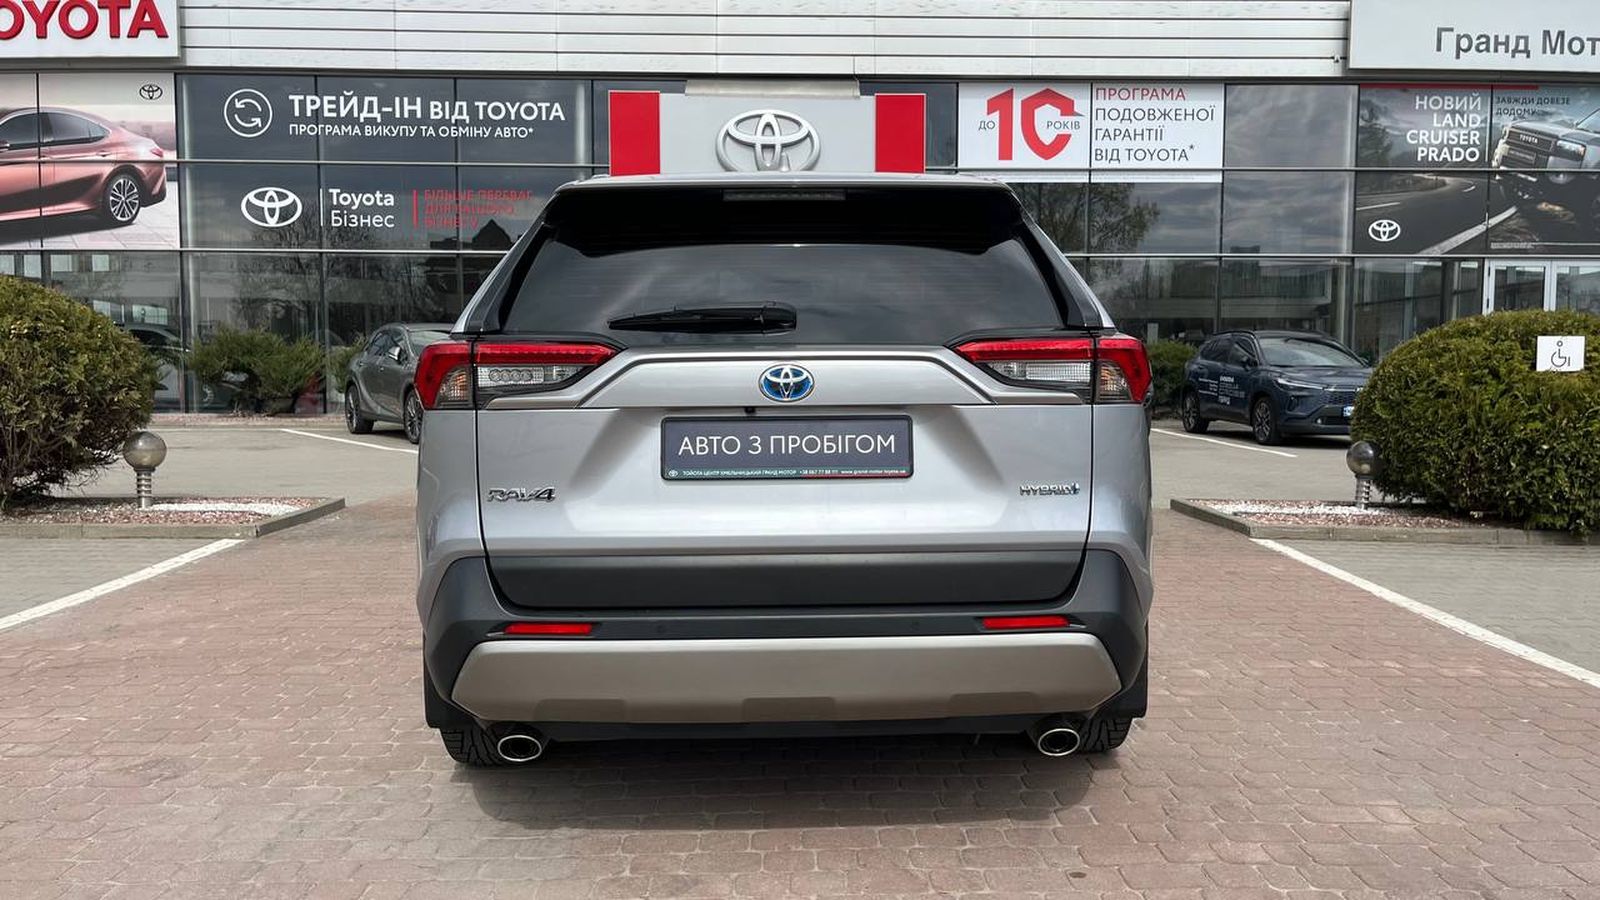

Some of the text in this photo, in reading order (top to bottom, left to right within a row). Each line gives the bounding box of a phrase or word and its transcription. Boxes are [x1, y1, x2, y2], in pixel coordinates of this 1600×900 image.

[1436, 27, 1531, 60] Гранд
[1095, 87, 1186, 101] ПРОГРАМА
[1414, 93, 1481, 111] НОВИЙ
[1496, 96, 1570, 105] ЗАВЖДИ ДОВЕЗЕ
[288, 90, 566, 123] ТРЕЙД-ІН ВІД TOYOTA
[1095, 105, 1216, 123] ПОДОВЖЕНОЇ
[1496, 107, 1536, 116] ДОДОМУ
[978, 120, 996, 131] ДО
[1046, 121, 1080, 130] РОКІВ
[1432, 113, 1481, 129] LAND
[288, 123, 362, 137] ПРОГРАМА
[364, 125, 418, 137] ВИКУПУ
[420, 126, 436, 138] ТА
[438, 126, 492, 138] ОБМІНУ
[1094, 125, 1165, 141] ГАРАНТІЇ
[1406, 130, 1481, 146] CRUISER
[1094, 148, 1120, 164] ВІД
[1417, 147, 1480, 163] PRADO
[329, 188, 395, 209] Toyota
[330, 209, 395, 228] Бізнес
[678, 434, 895, 456] АВТО З ПРОБІГОМ
[487, 486, 556, 502] RAV4
[1020, 484, 1072, 496] HYBRID
